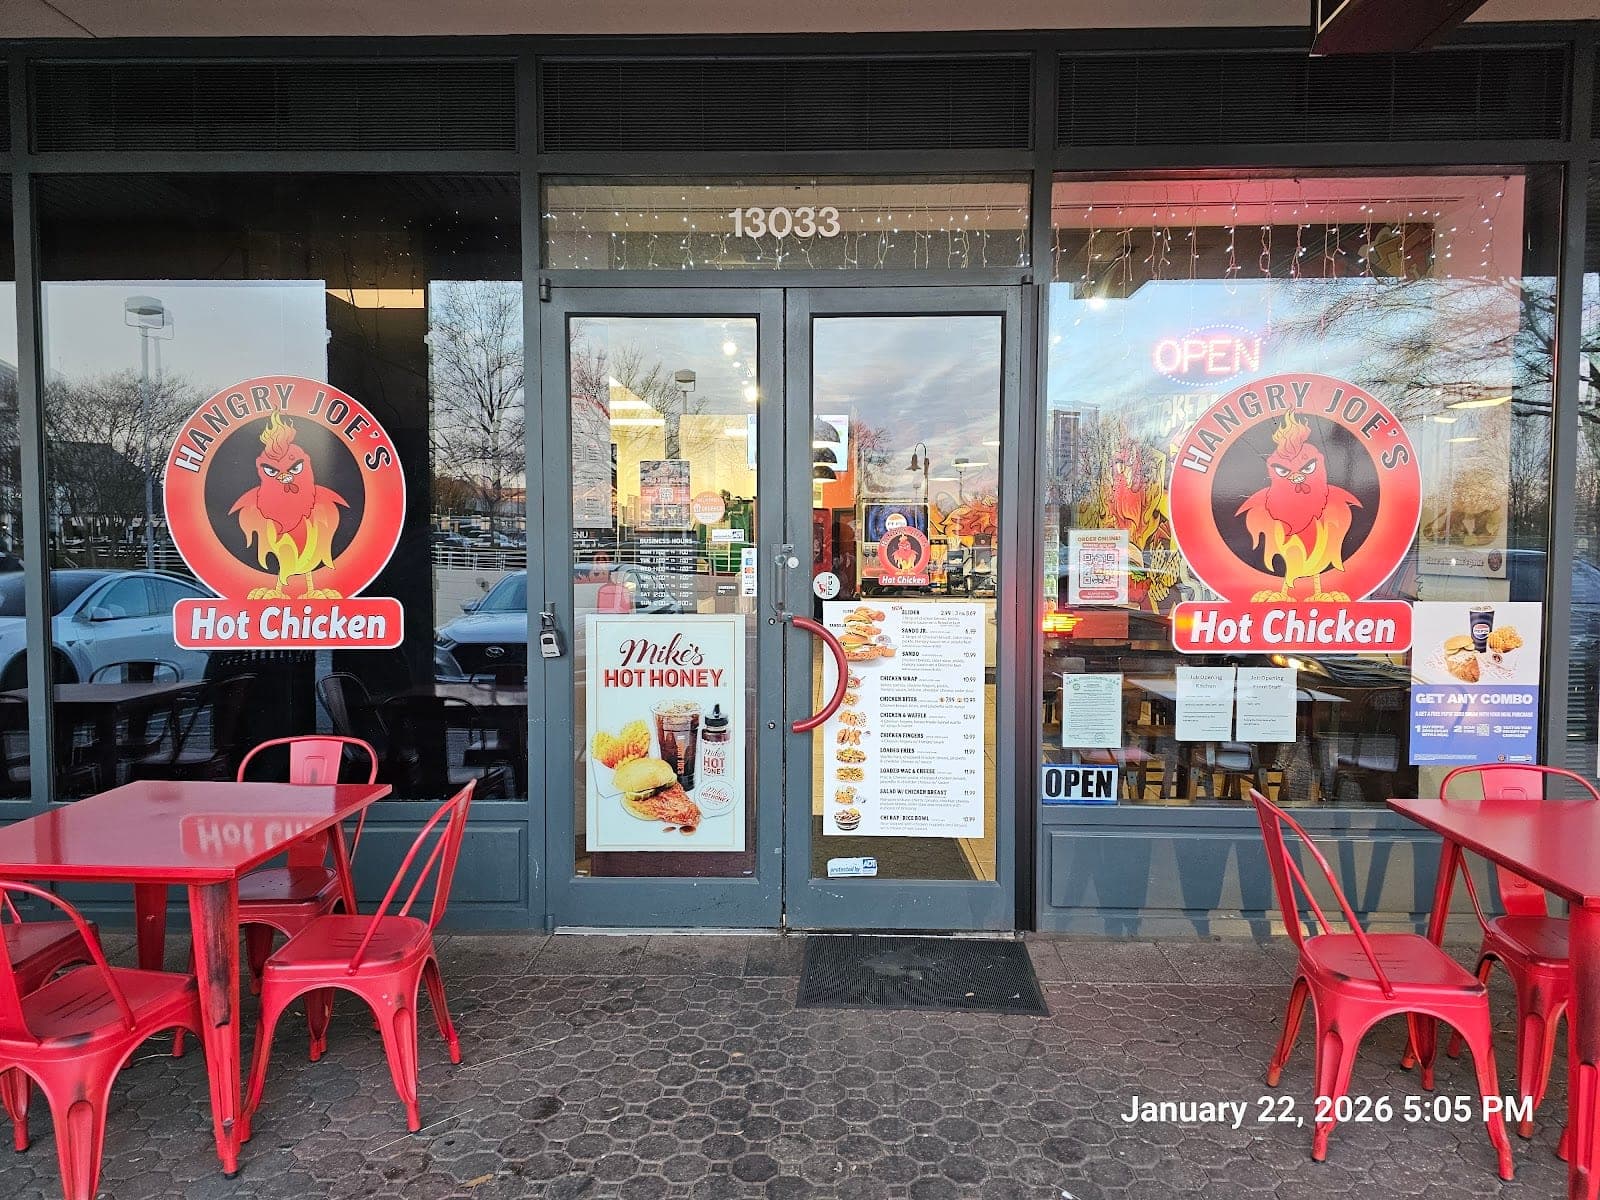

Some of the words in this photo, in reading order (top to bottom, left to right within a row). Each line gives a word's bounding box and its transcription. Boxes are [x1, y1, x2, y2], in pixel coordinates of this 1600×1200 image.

[728, 206, 841, 238] 13033
[1155, 338, 1262, 373] OPEN
[174, 383, 295, 474] HANGRY
[308, 391, 392, 473] JOE'S
[1181, 381, 1311, 474] HANGRY
[1325, 388, 1409, 472] JOE'S
[882, 576, 895, 584] Hot
[897, 575, 926, 584] Chicken
[191, 607, 250, 640] Hot
[259, 605, 386, 640] Chicken
[1190, 610, 1254, 644] Hot
[1262, 608, 1396, 644] Chicken
[619, 632, 705, 667] Mike's
[604, 668, 646, 688] HOT
[649, 668, 724, 688] HONEY
[1415, 693, 1445, 704] GET
[1447, 694, 1478, 704] ANY
[1480, 693, 1533, 705] COMBO
[1415, 725, 1421, 733] 1
[1453, 725, 1463, 733] 2
[1493, 725, 1502, 733] 3
[703, 756, 725, 768] HOT
[1045, 769, 1113, 798] OPEN
